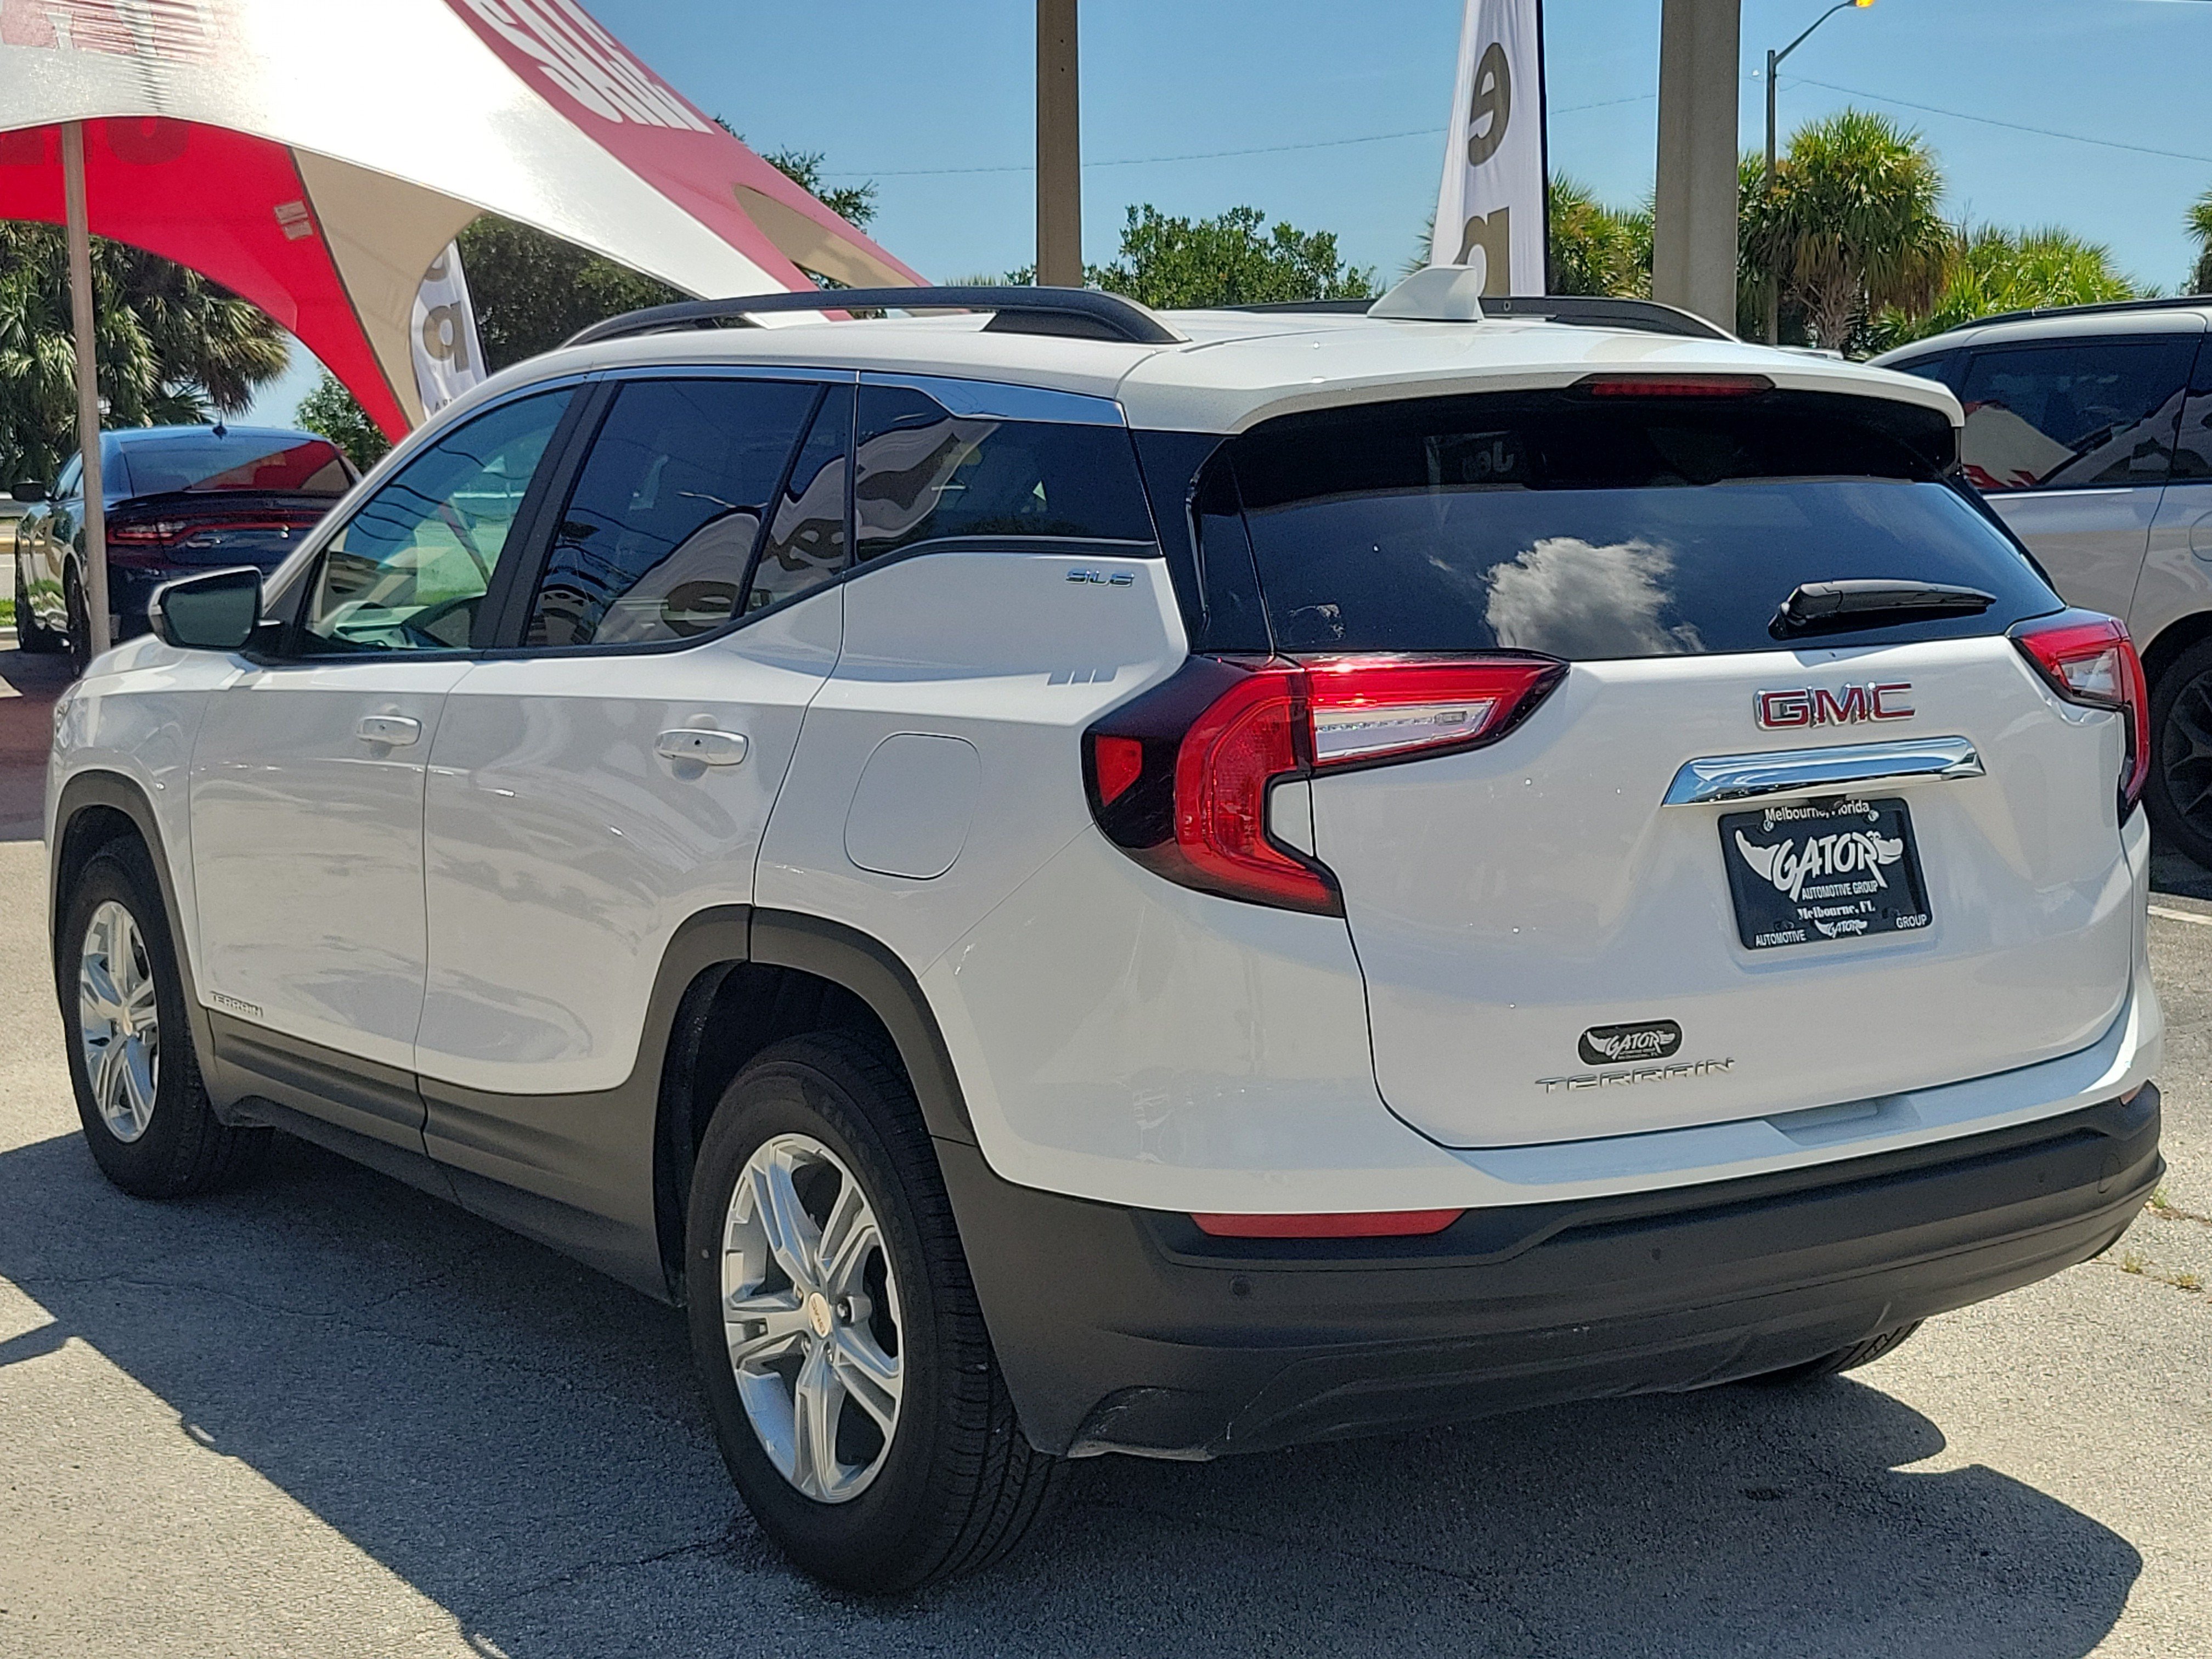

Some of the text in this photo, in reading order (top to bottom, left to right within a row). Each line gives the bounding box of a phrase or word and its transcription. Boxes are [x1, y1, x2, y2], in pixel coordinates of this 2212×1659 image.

[1753, 681, 1915, 731] GMC
[1773, 832, 1888, 902] GATOR
[1802, 880, 1878, 900] AUTOMOTIVE GROUP
[1827, 920, 1862, 938] GATOR
[1896, 914, 1927, 929] GROUP
[1756, 929, 1807, 946] AUTOMOTIVE
[1605, 1031, 1662, 1060] GATOR
[1535, 1057, 1735, 1094] TERRAIN
